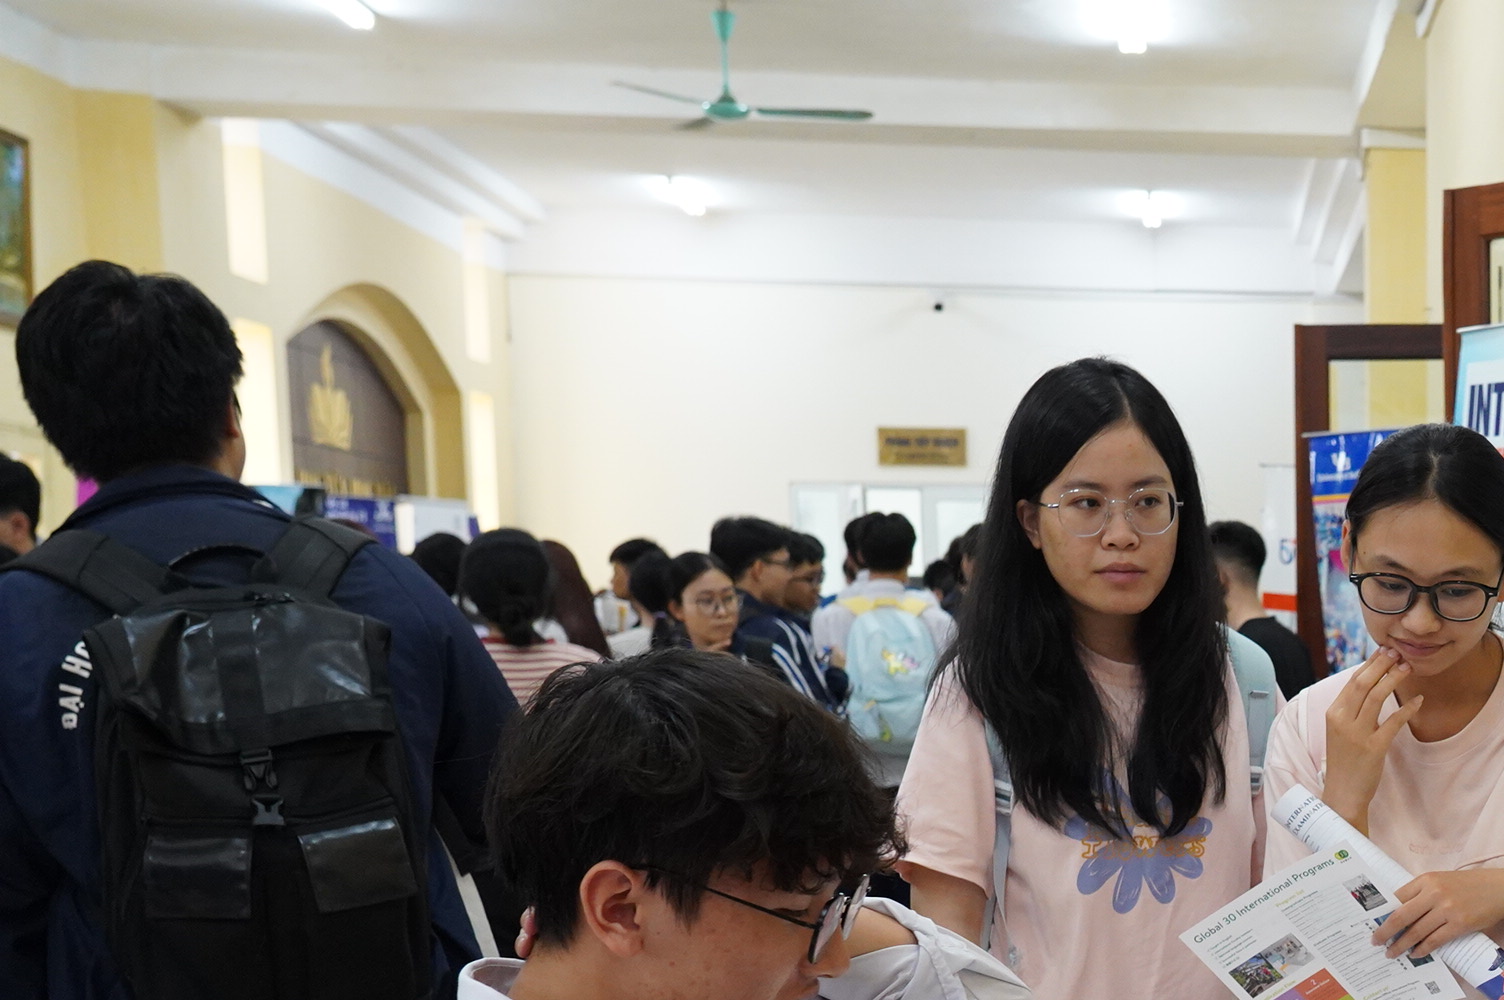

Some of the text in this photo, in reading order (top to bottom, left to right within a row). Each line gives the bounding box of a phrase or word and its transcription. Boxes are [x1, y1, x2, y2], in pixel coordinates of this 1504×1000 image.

[1193, 857, 1335, 944] Global 30 International Programs
